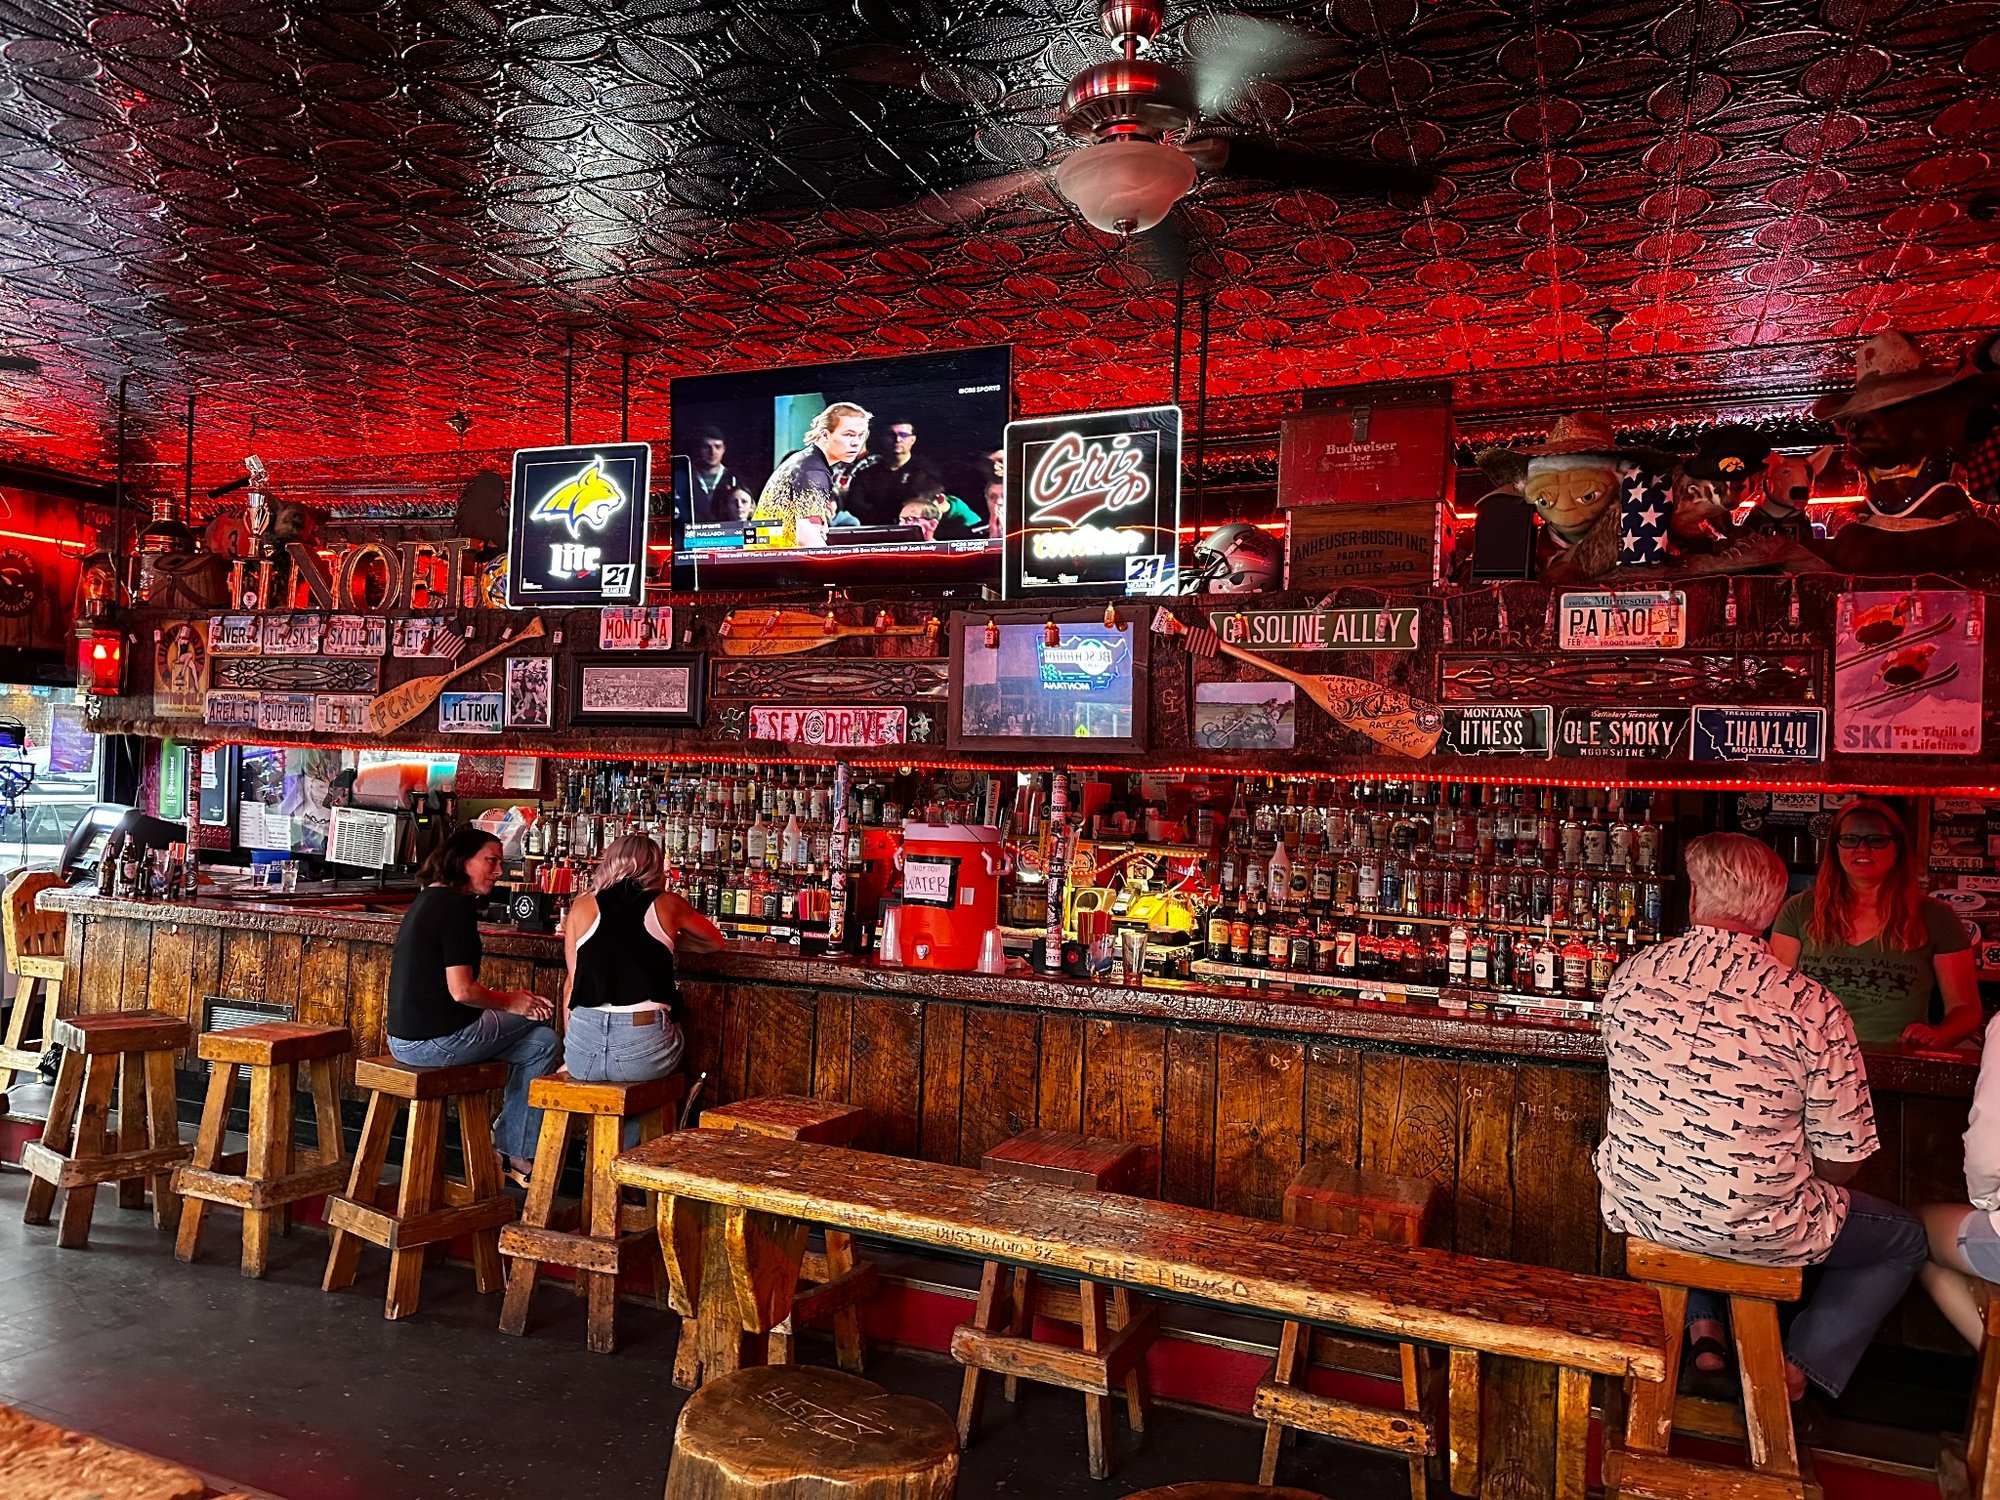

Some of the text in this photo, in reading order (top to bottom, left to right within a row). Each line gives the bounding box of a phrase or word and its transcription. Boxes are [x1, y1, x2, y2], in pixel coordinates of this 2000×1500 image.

[1326, 441, 1397, 455] Budweiser
[1031, 432, 1150, 512] Griz
[547, 542, 602, 579] Lite
[1336, 549, 1385, 561] PROPERTY
[604, 567, 631, 587] 21
[1129, 558, 1160, 581] 21
[1594, 596, 1651, 606] Minnesota
[330, 628, 382, 647] SKIDOW
[605, 617, 667, 640] MONTNA
[1223, 613, 1403, 643] GASOLINE ALLEY
[1567, 638, 1580, 646] FEB
[209, 701, 256, 721] AREA 51
[443, 703, 499, 722] LTLTRUK
[1463, 708, 1523, 718] MONTANA
[768, 711, 887, 743] SEX DRIVE
[1563, 721, 1674, 746] OLE SMOKY
[1724, 720, 1808, 749] IHAV14U
[1843, 725, 1976, 749] SKI The Thrill of
[1900, 739, 1967, 751] a Lifetime
[1580, 749, 1645, 758] MOONSHINE
[1731, 747, 1785, 755] MONTANA
[905, 876, 948, 893] WATER
[1338, 941, 1351, 964] 7
[1827, 955, 1866, 965] CREEK
[1871, 958, 1918, 974] SALOON
